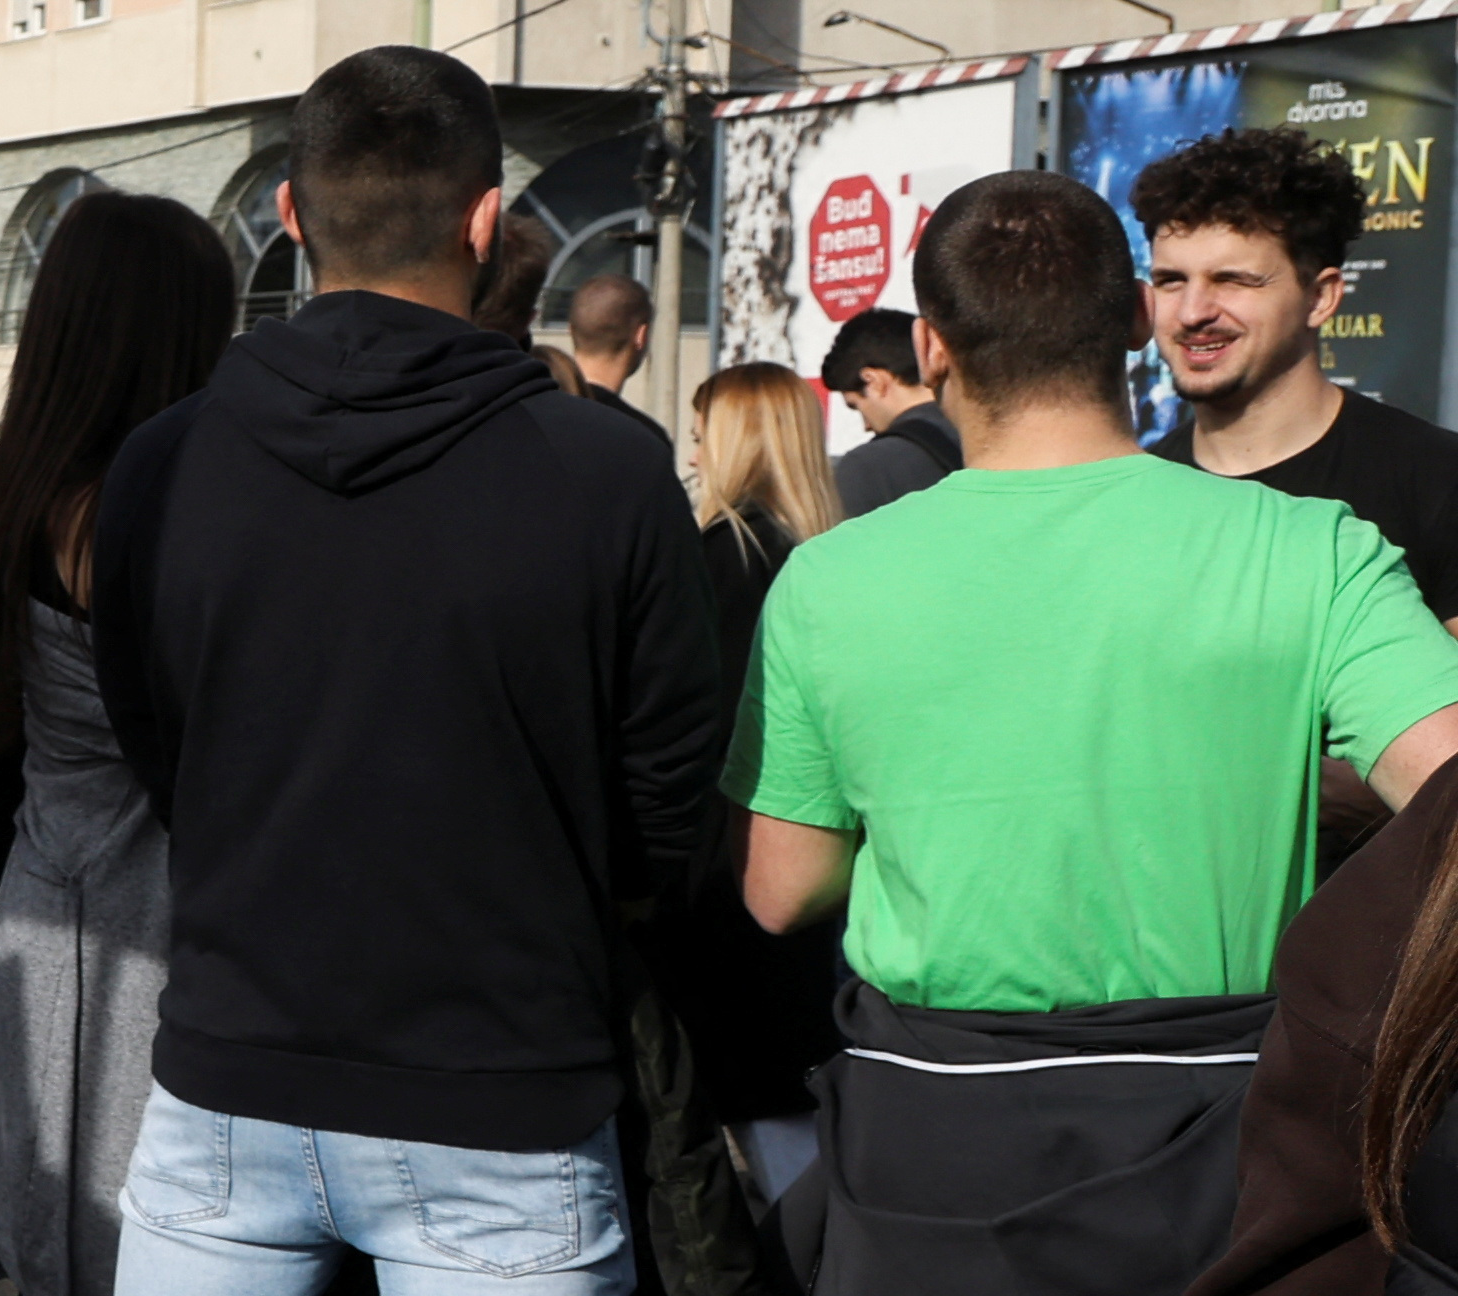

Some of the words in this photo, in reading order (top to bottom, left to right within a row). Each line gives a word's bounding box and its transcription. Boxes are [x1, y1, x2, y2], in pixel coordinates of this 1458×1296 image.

[1287, 100, 1368, 123] dvorana
[818, 223, 881, 254] nema
[814, 246, 885, 284] šansu!
[1320, 313, 1384, 339] RUAR
